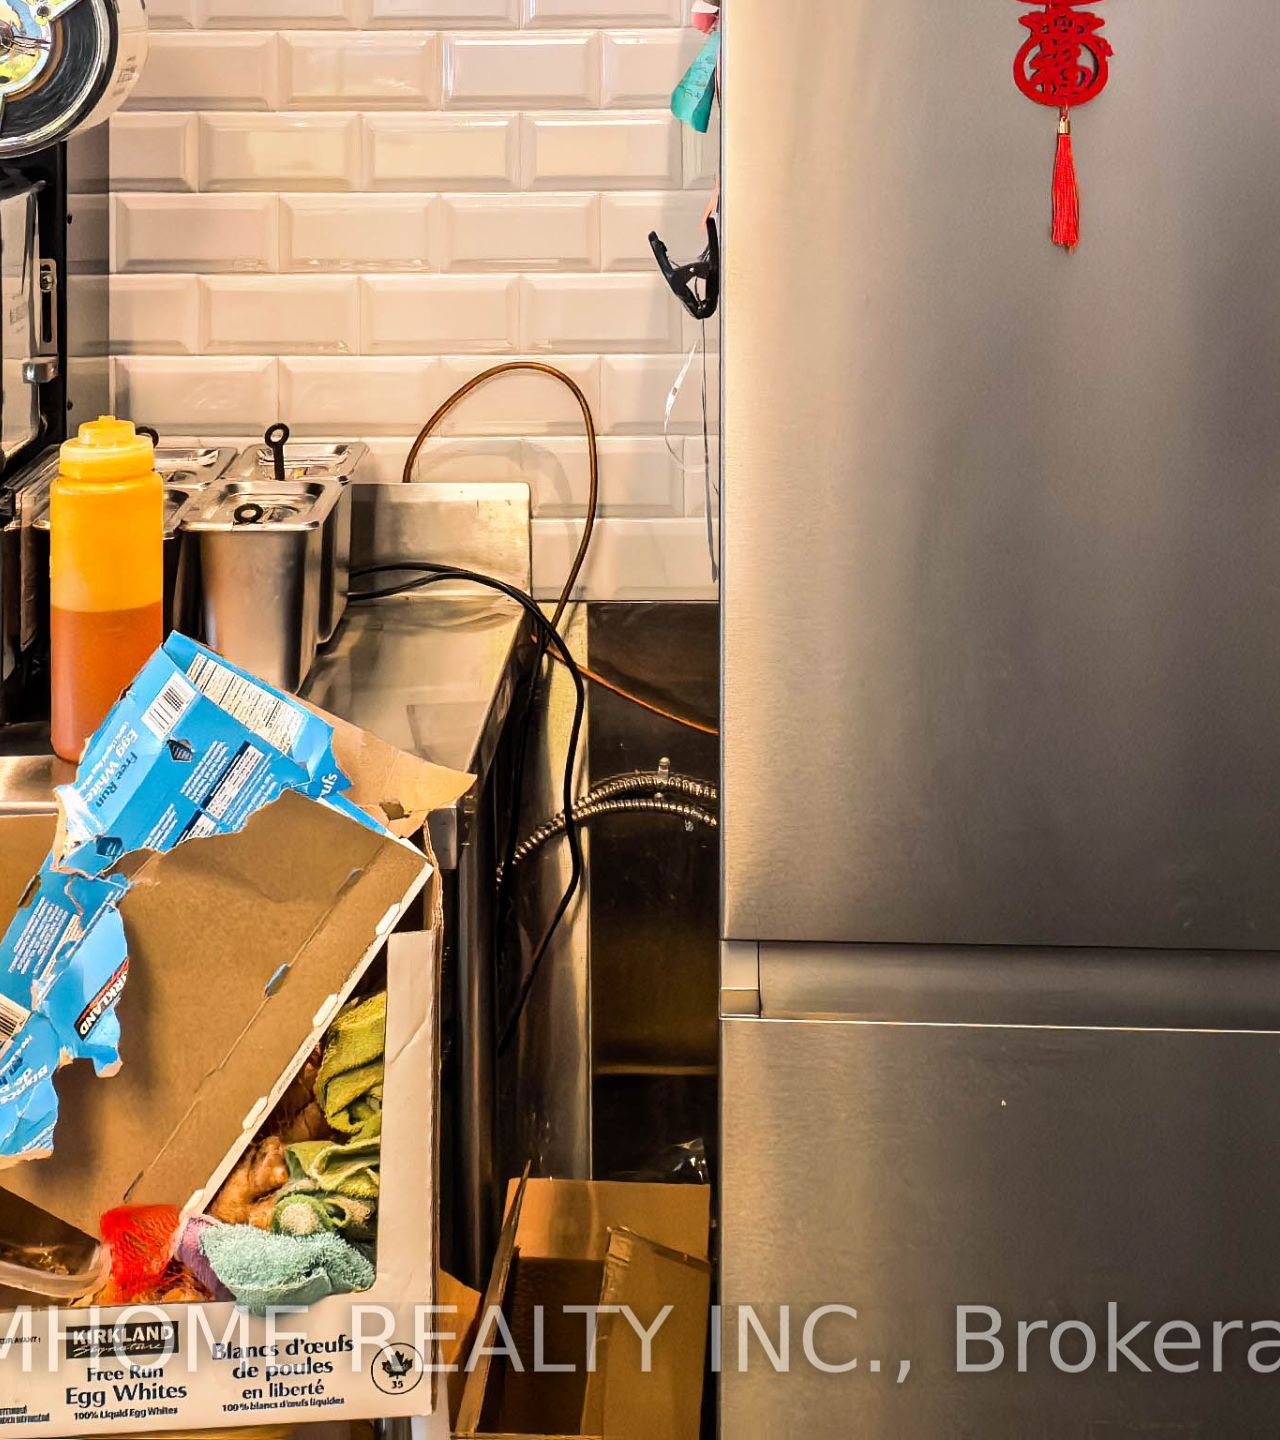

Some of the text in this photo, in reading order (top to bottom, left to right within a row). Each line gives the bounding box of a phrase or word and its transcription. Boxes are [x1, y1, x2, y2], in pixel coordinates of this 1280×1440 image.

[116, 751, 138, 780] Free
[95, 781, 118, 808] Run
[80, 970, 128, 1035] IRKLAND
[73, 1325, 174, 1345] KIRKLAND
[212, 1341, 279, 1360] Blancs
[87, 1365, 164, 1382] Free Run
[233, 1357, 334, 1382] de poules
[65, 1382, 188, 1409] Egg Whites
[242, 1379, 325, 1400] en liberté
[74, 1406, 178, 1421] 100% Liquid Egg Whites
